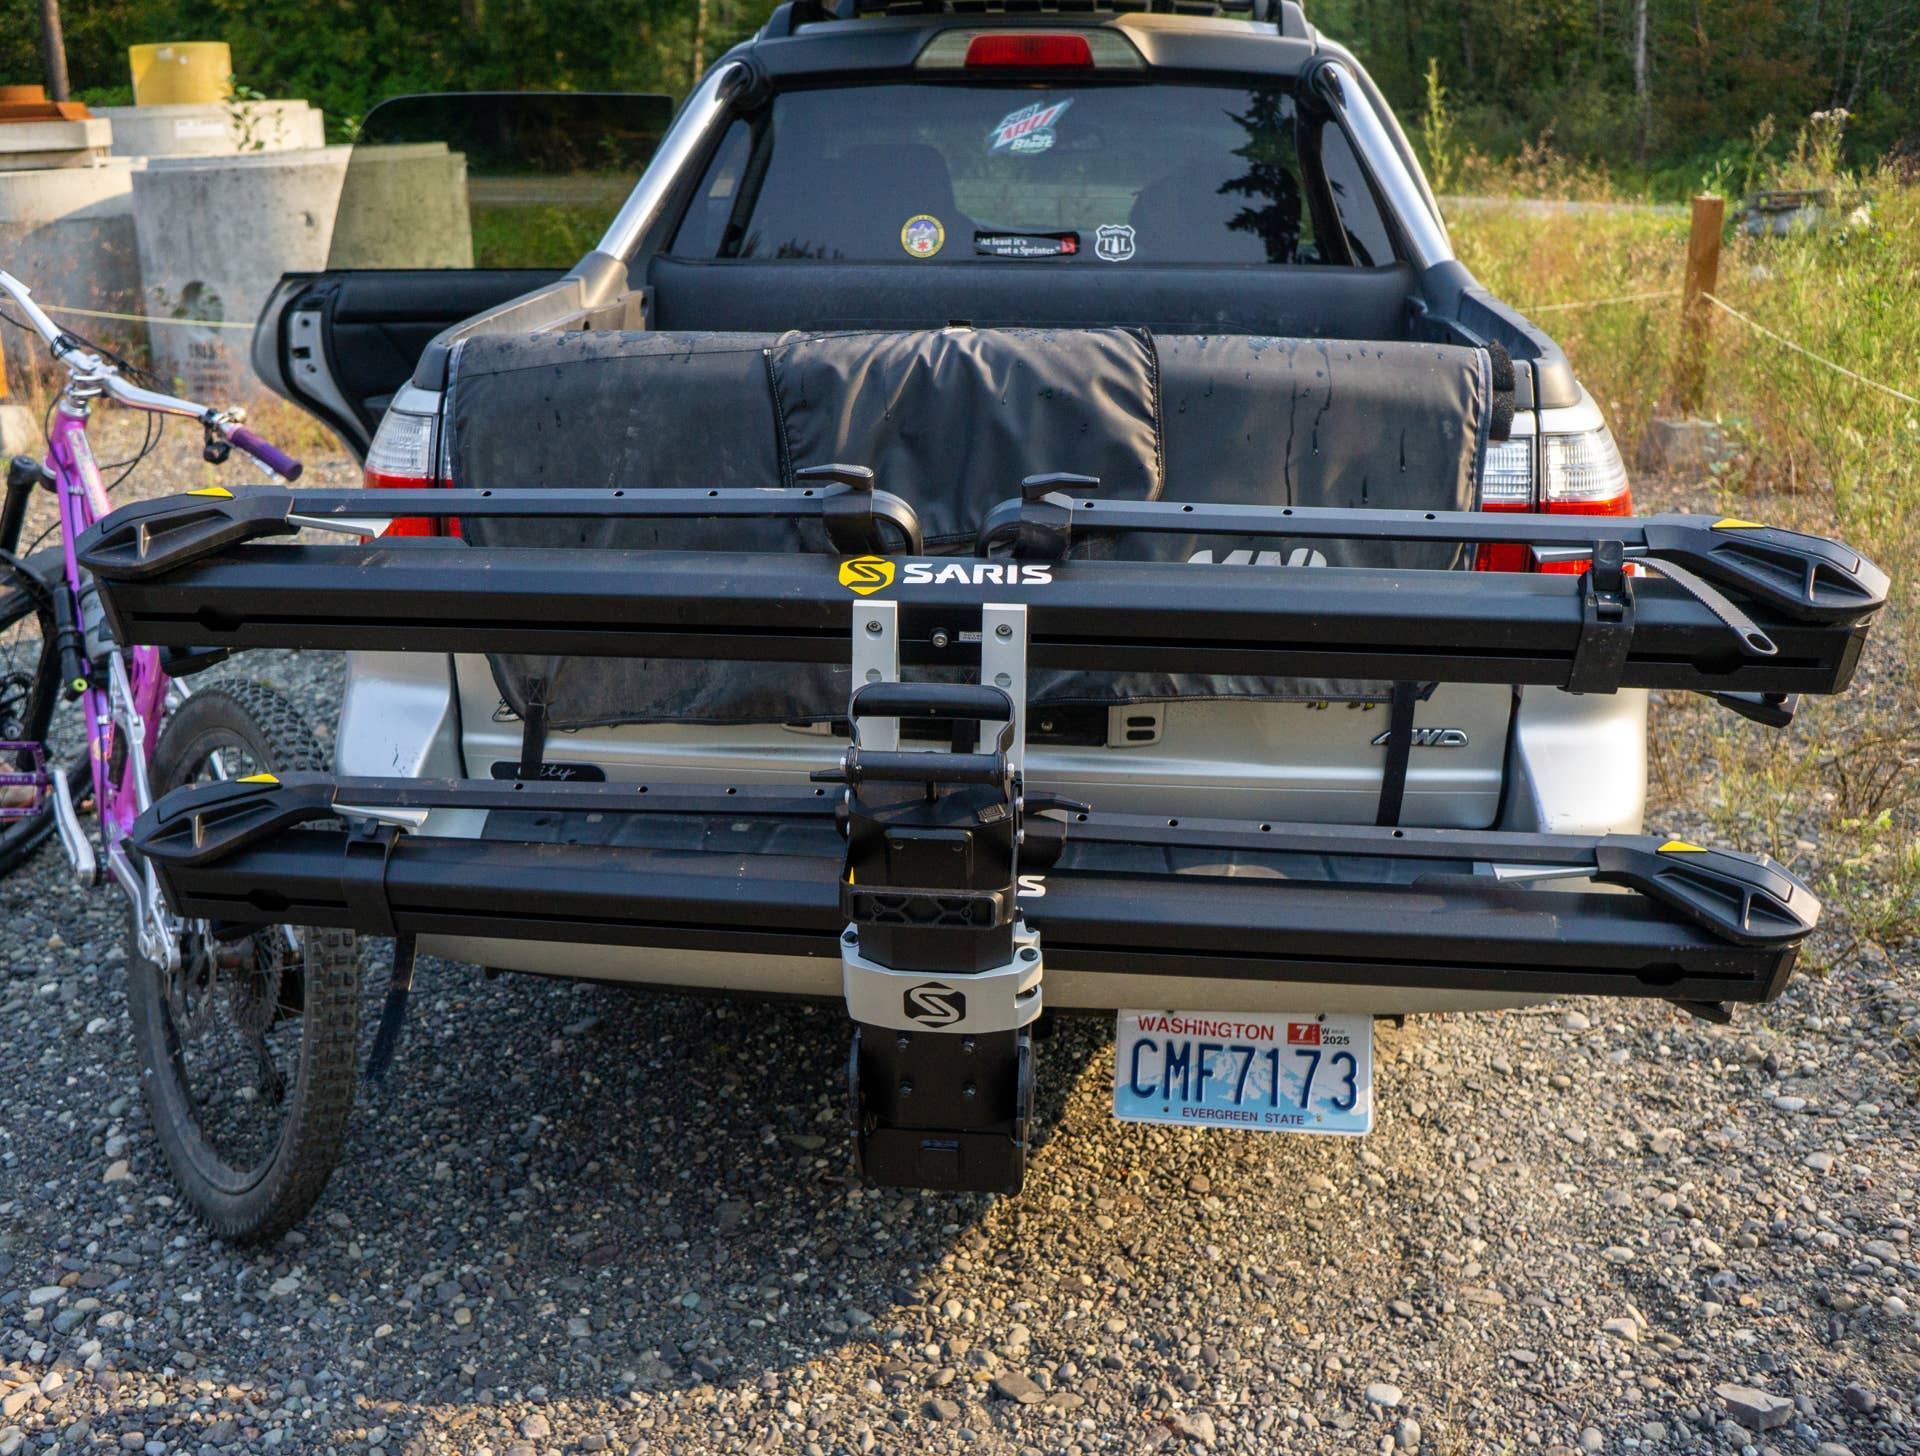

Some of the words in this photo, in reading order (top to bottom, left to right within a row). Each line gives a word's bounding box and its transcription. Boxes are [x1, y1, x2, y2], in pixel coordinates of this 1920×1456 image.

[1010, 137, 1055, 151] Blast
[992, 237, 1012, 246] least
[1013, 237, 1027, 246] it's
[996, 246, 1012, 254] not
[902, 563, 1053, 586] SARIS
[1138, 1015, 1275, 1041] WASHINGTON
[1296, 1025, 1310, 1040] 7
[1322, 1035, 1350, 1045] 2025
[1130, 1038, 1360, 1111] CMF7173
[1182, 1106, 1258, 1122] EVERGREEN
[1265, 1112, 1304, 1125] STATE
